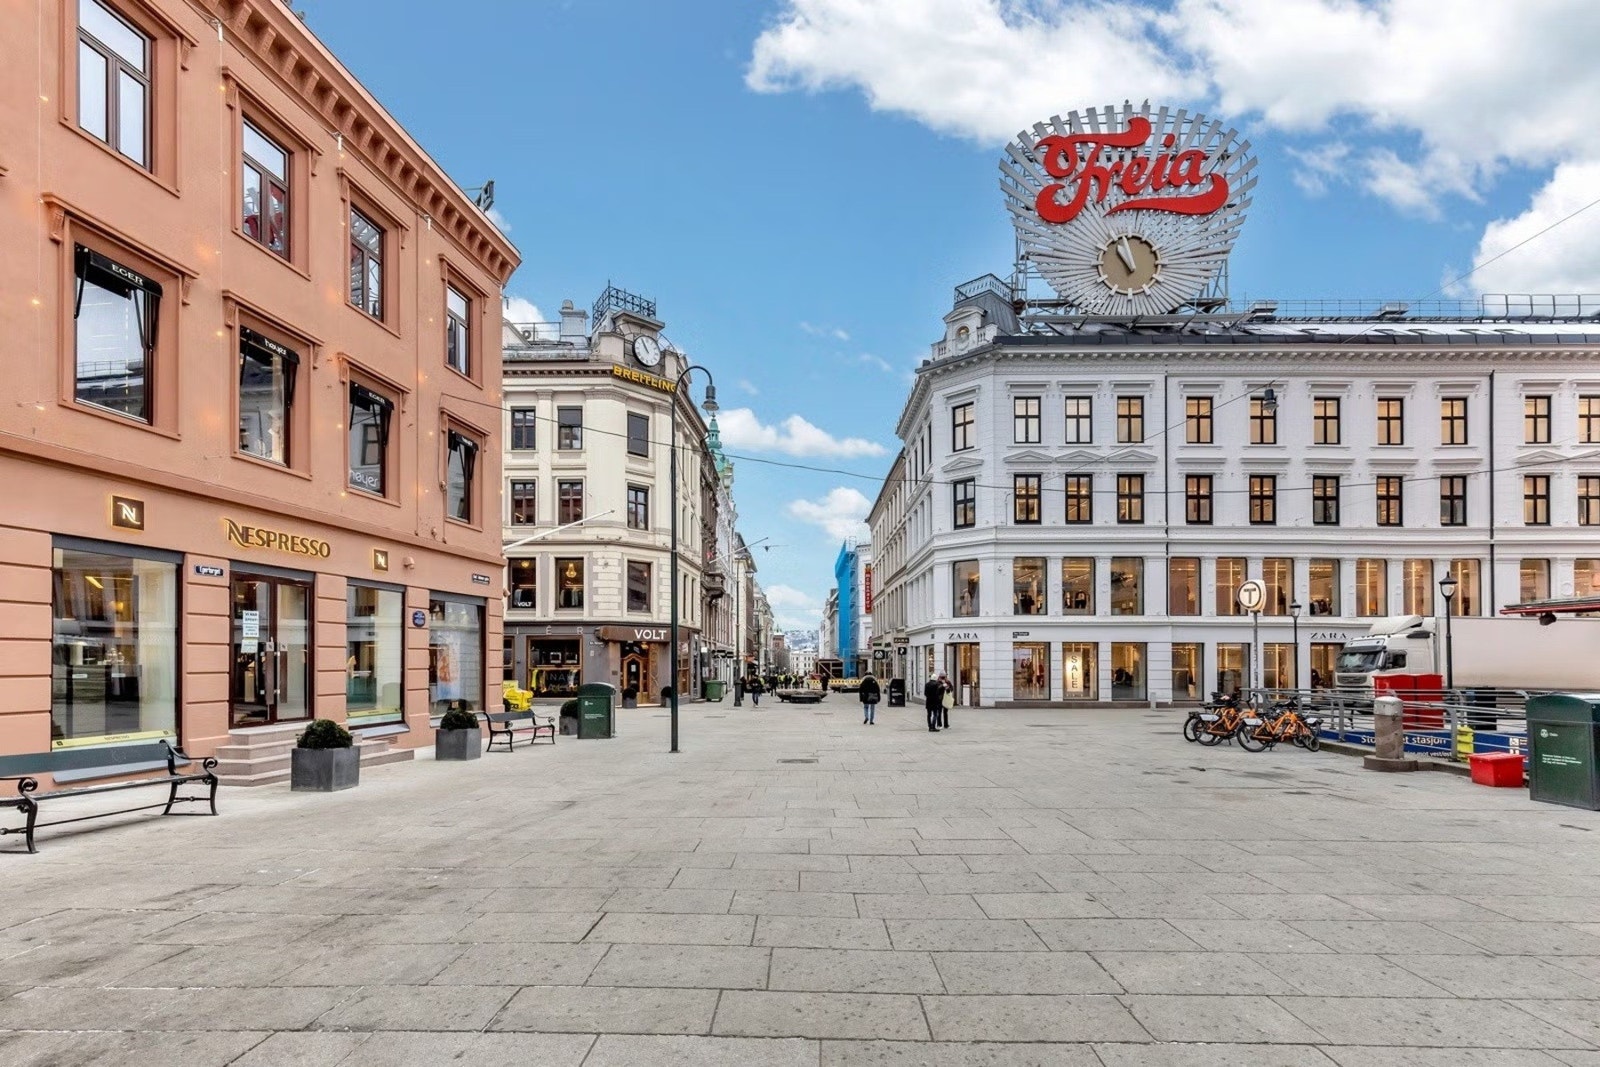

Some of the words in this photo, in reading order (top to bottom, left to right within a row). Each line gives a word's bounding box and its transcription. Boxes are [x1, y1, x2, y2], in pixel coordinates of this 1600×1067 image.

[1034, 116, 1229, 224] Freia
[111, 263, 144, 287] EGER
[613, 363, 677, 392] BREITLING
[224, 517, 331, 558] NESPRESSO
[1243, 587, 1257, 605] T
[634, 628, 667, 640] VOLT
[948, 632, 979, 640] ZARA
[1071, 655, 1079, 689] SALE
[1412, 735, 1447, 746] stasjon
